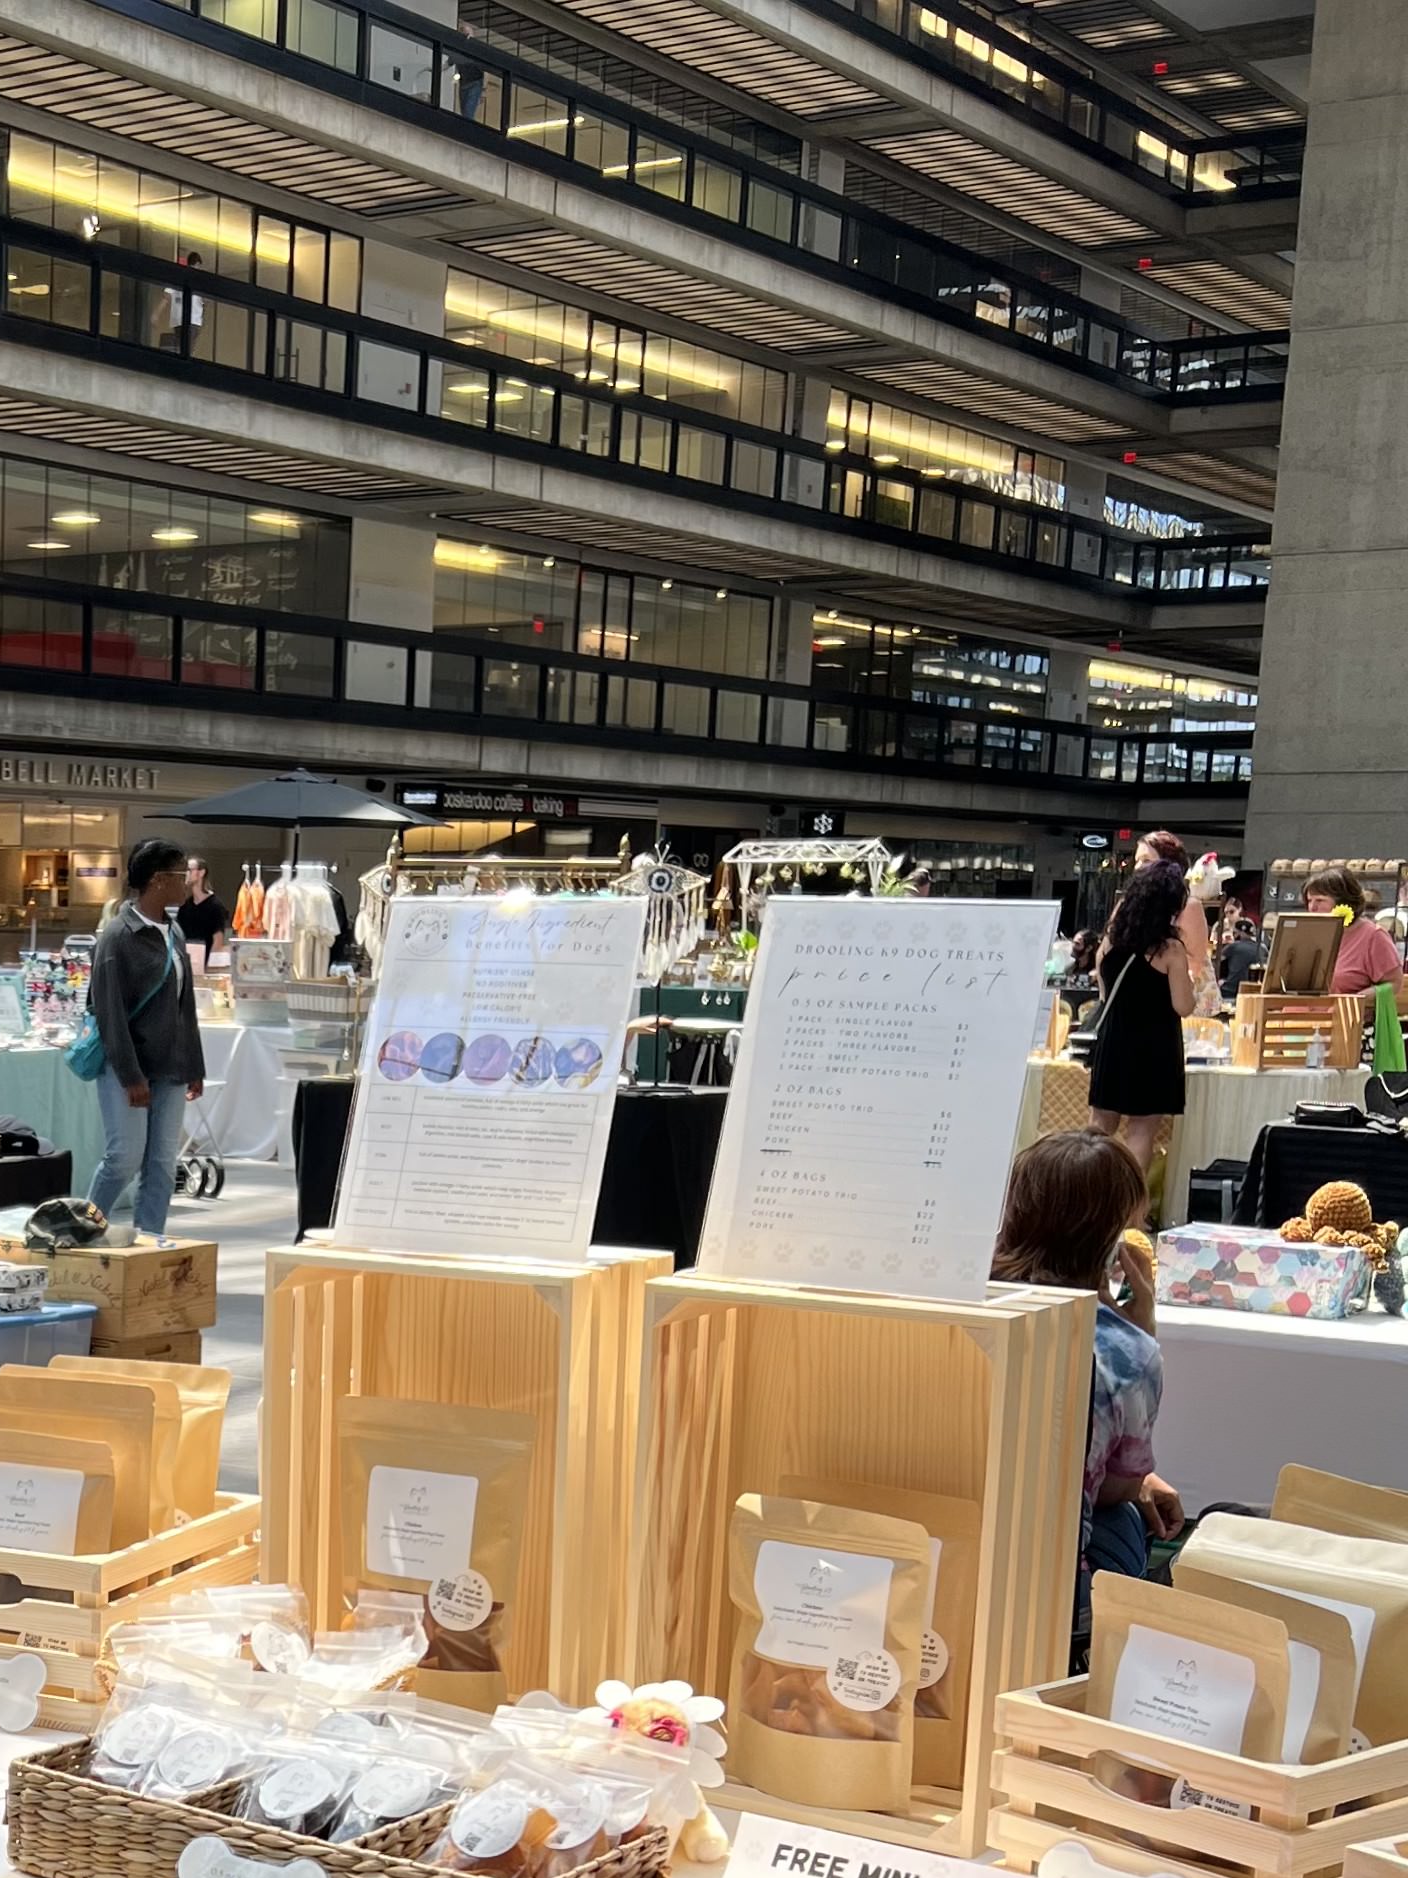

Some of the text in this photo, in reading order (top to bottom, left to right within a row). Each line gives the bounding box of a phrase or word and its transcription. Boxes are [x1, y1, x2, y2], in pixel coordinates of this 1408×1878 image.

[0, 758, 161, 790] BELL MARKET
[494, 793, 524, 812] coffee
[533, 796, 564, 817] baking
[573, 941, 612, 956] Dogs
[794, 944, 1005, 962] DROOLING K9 DOG TREATS
[778, 962, 1009, 999] price list
[816, 999, 834, 1009] OZ
[838, 1000, 889, 1012] SAMPLE
[893, 1002, 938, 1013] PACKS
[835, 1017, 871, 1026] SINGLE
[875, 1019, 914, 1028] FLAVOR
[863, 1031, 909, 1041] FLAVORS
[837, 1042, 867, 1051] THREE
[871, 1044, 917, 1054] FLAVORS
[825, 1066, 858, 1075] SWEET
[861, 1068, 901, 1077] POTATO
[905, 1071, 929, 1079] TRIO
[786, 1085, 804, 1094] OZ
[808, 1086, 843, 1097] BAGS
[807, 1102, 846, 1112] POTATO
[850, 1104, 874, 1113] TRIO
[769, 1112, 950, 1132] BEEF $12
[764, 1136, 790, 1145] PORK
[767, 1124, 948, 1145] CHICKEN $12
[770, 1170, 788, 1179] OZ
[792, 1171, 827, 1183] BAGS
[753, 1197, 777, 1206] BEEF
[834, 1191, 858, 1201] TRIO
[751, 1209, 794, 1220] CHICKEN
[748, 1221, 774, 1230] PORK
